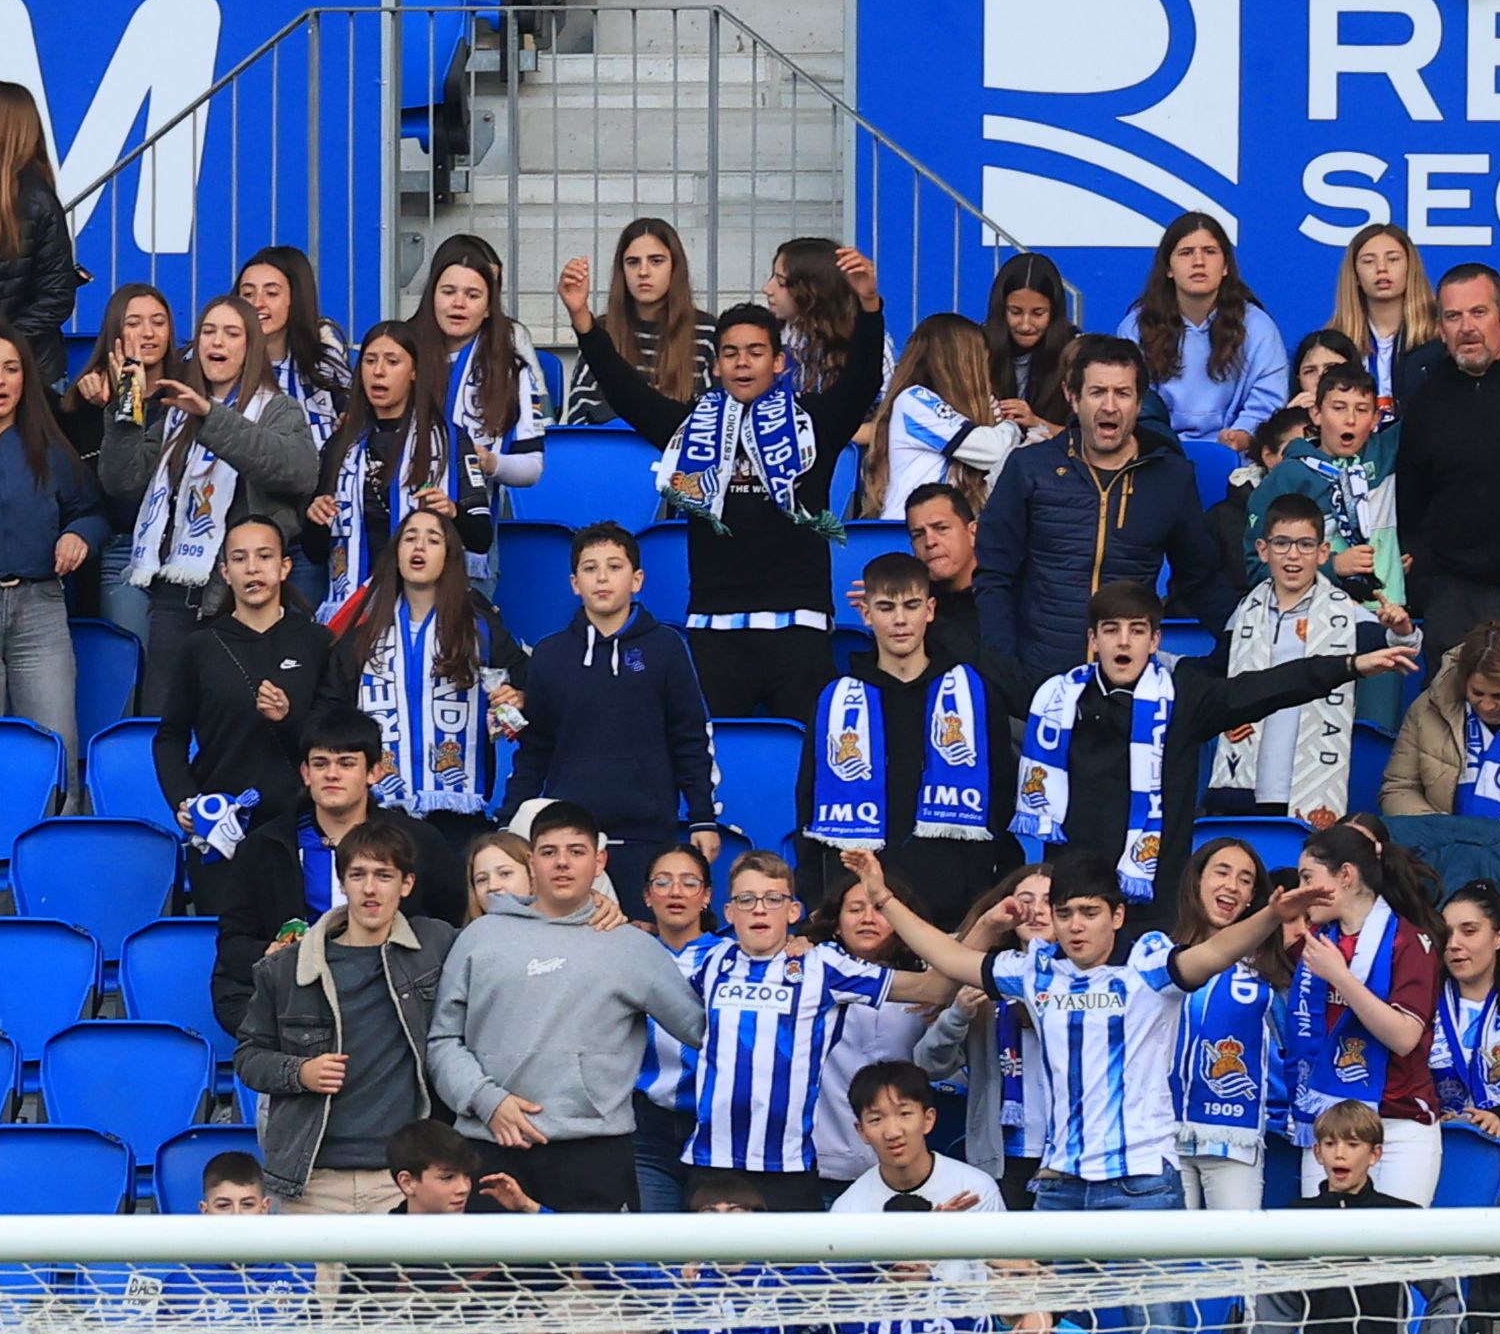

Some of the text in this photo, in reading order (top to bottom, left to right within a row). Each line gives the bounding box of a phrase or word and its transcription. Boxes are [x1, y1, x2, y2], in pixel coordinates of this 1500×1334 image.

[174, 542, 205, 558] 1909
[922, 785, 984, 812] IMQ
[818, 802, 881, 824] IMQ
[717, 983, 790, 1004] CAZOO
[1053, 994, 1126, 1012] YASUDA
[1203, 1101, 1244, 1117] 1909
